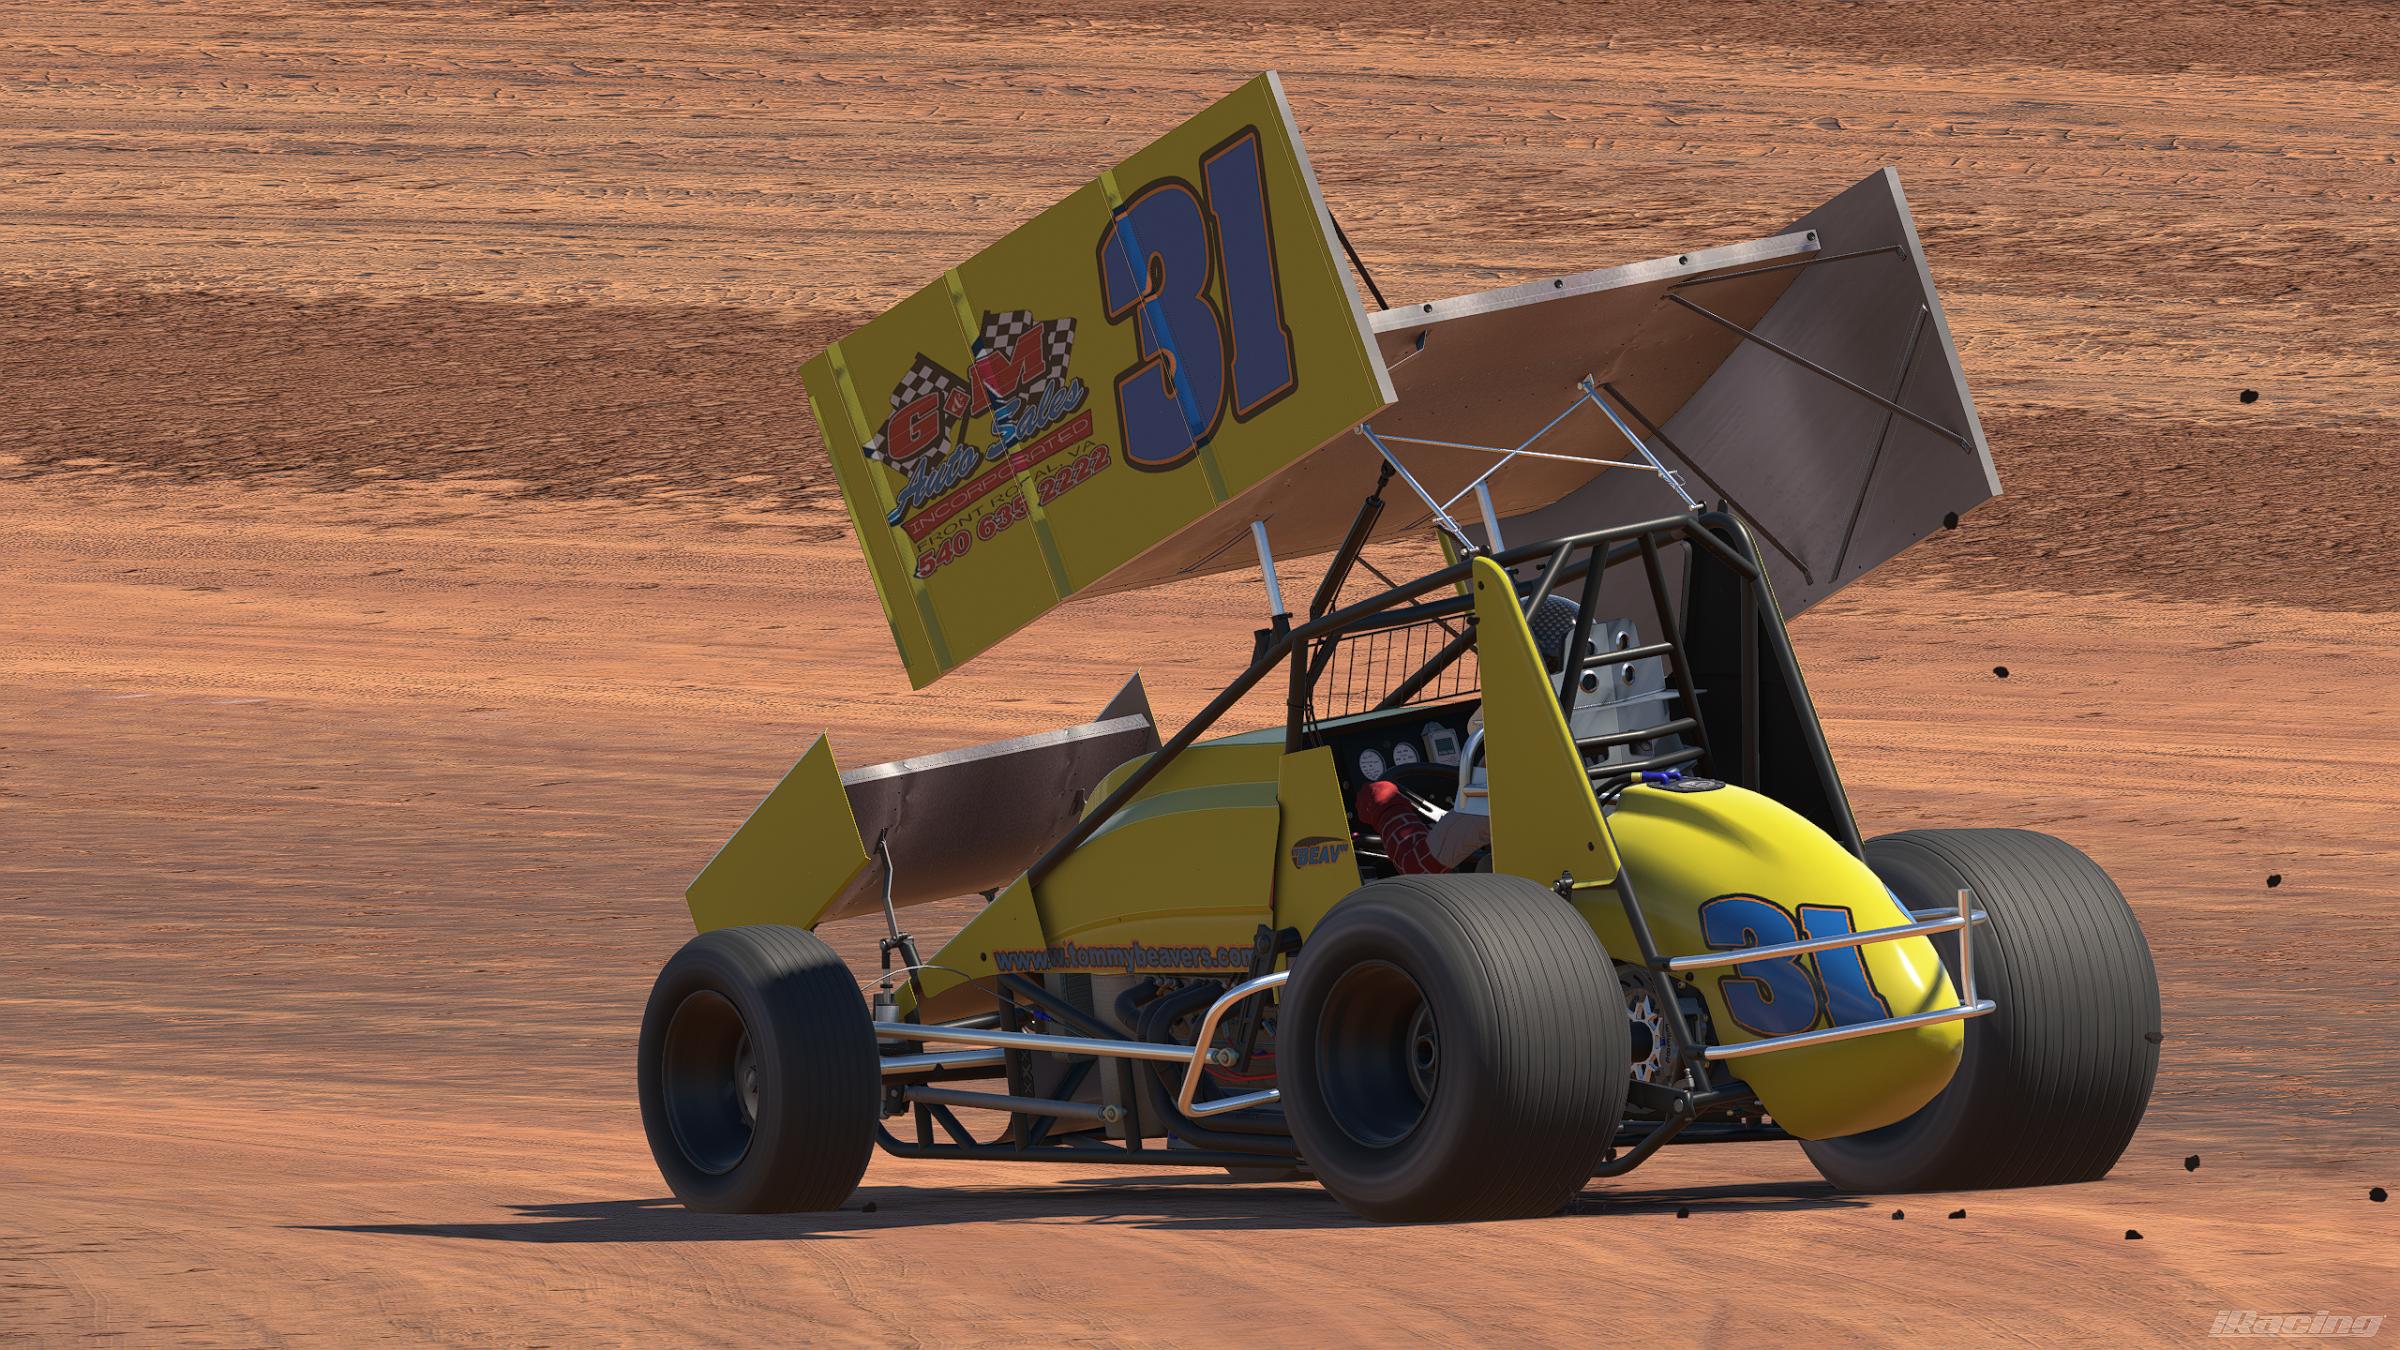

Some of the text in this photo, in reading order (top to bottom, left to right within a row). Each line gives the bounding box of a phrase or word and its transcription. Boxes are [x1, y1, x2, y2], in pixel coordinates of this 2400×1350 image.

[1096, 124, 1299, 473] 31
[887, 391, 940, 460] G
[968, 321, 1046, 417] M
[887, 376, 1088, 527] Auto Sales
[909, 418, 1090, 535] INCORPORATED
[914, 444, 1112, 579] 540 635 2222
[916, 507, 983, 553] FRONT
[1068, 440, 1096, 459] VA
[1698, 893, 1894, 1038] 31
